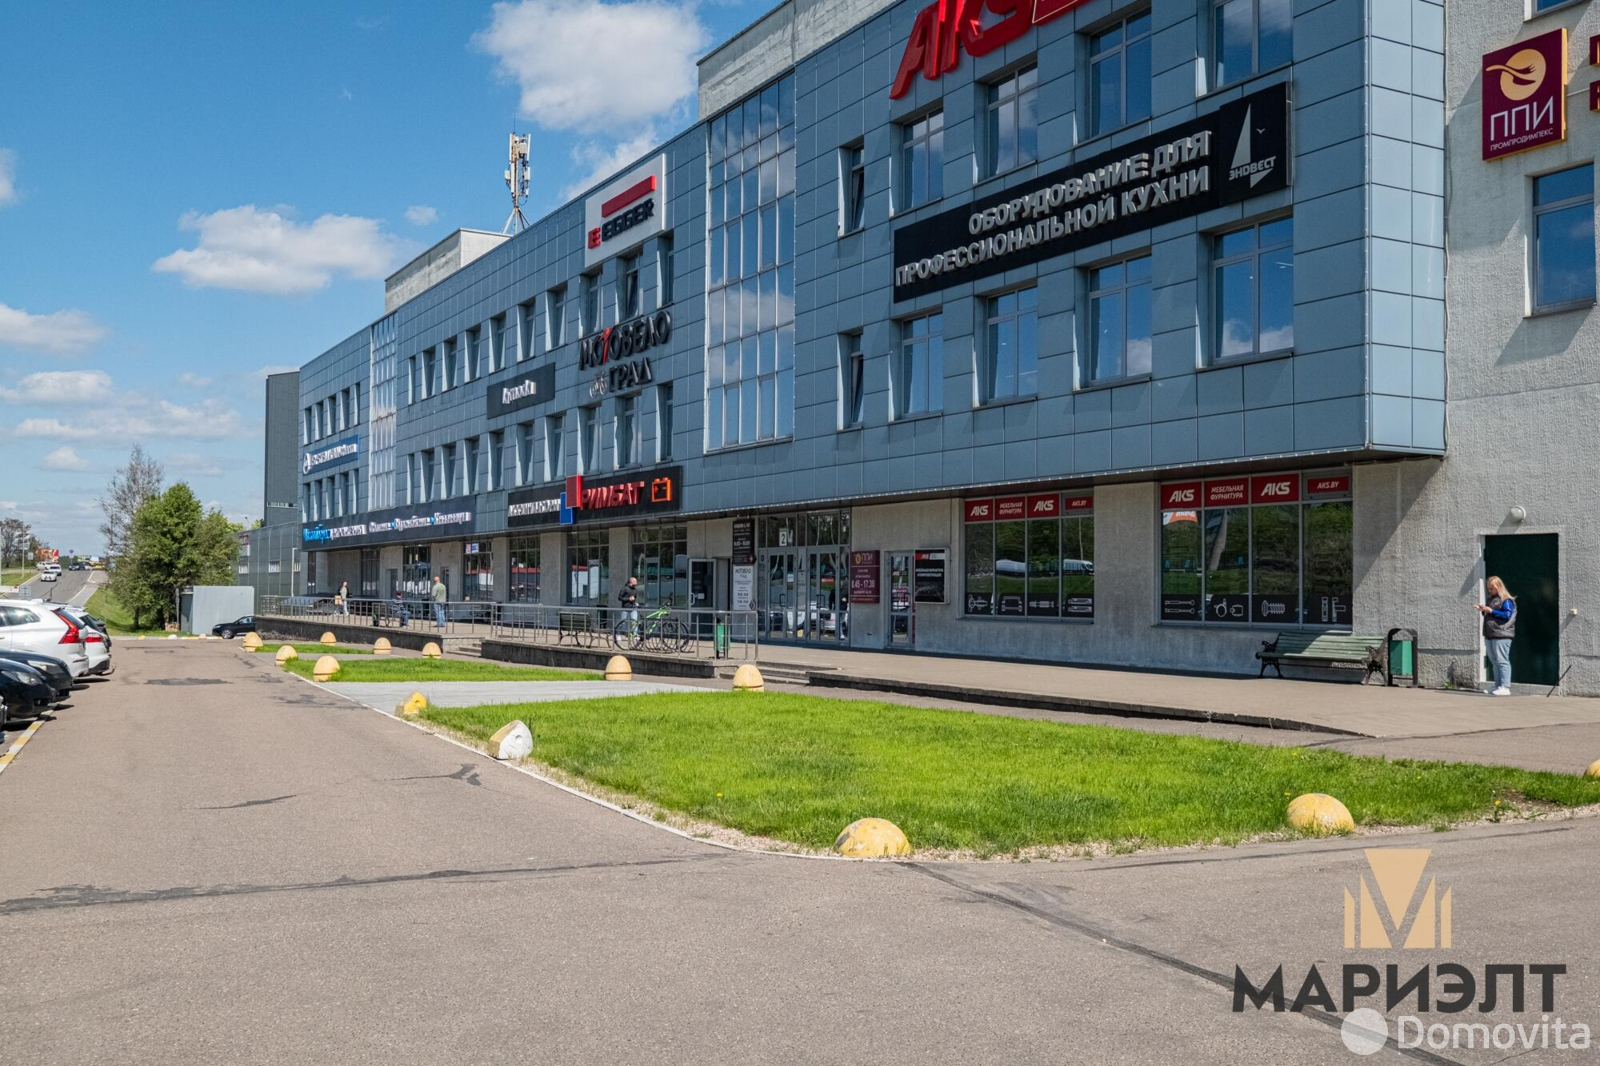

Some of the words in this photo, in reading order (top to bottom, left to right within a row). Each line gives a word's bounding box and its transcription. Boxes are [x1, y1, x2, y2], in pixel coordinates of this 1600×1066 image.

[1490, 96, 1554, 142] ППИ
[1490, 127, 1554, 152] ПРОМПРОДИМПЕКС
[1228, 155, 1277, 182] ЭНДВЕСТ
[968, 152, 1149, 235] ОБОРУДОВАНИЕ
[1151, 130, 1212, 176] ДЛЯ
[602, 198, 655, 242] EGGER
[895, 194, 1115, 287] ПРОФЕССИОНАЛЬНОЙ
[1121, 165, 1211, 216] КУХНИ
[579, 311, 672, 371] МОТОВЕЛО
[609, 357, 652, 393] ГРАД
[1169, 489, 1195, 503] AKS
[1210, 492, 1244, 501] ФУРНИТУРА
[1211, 485, 1244, 493] МЕБЕЛЬНАЯ
[1261, 481, 1291, 497] AKS
[1317, 481, 1340, 490] AKS.BY
[970, 505, 989, 517] AKS
[1033, 500, 1055, 512] AKS
